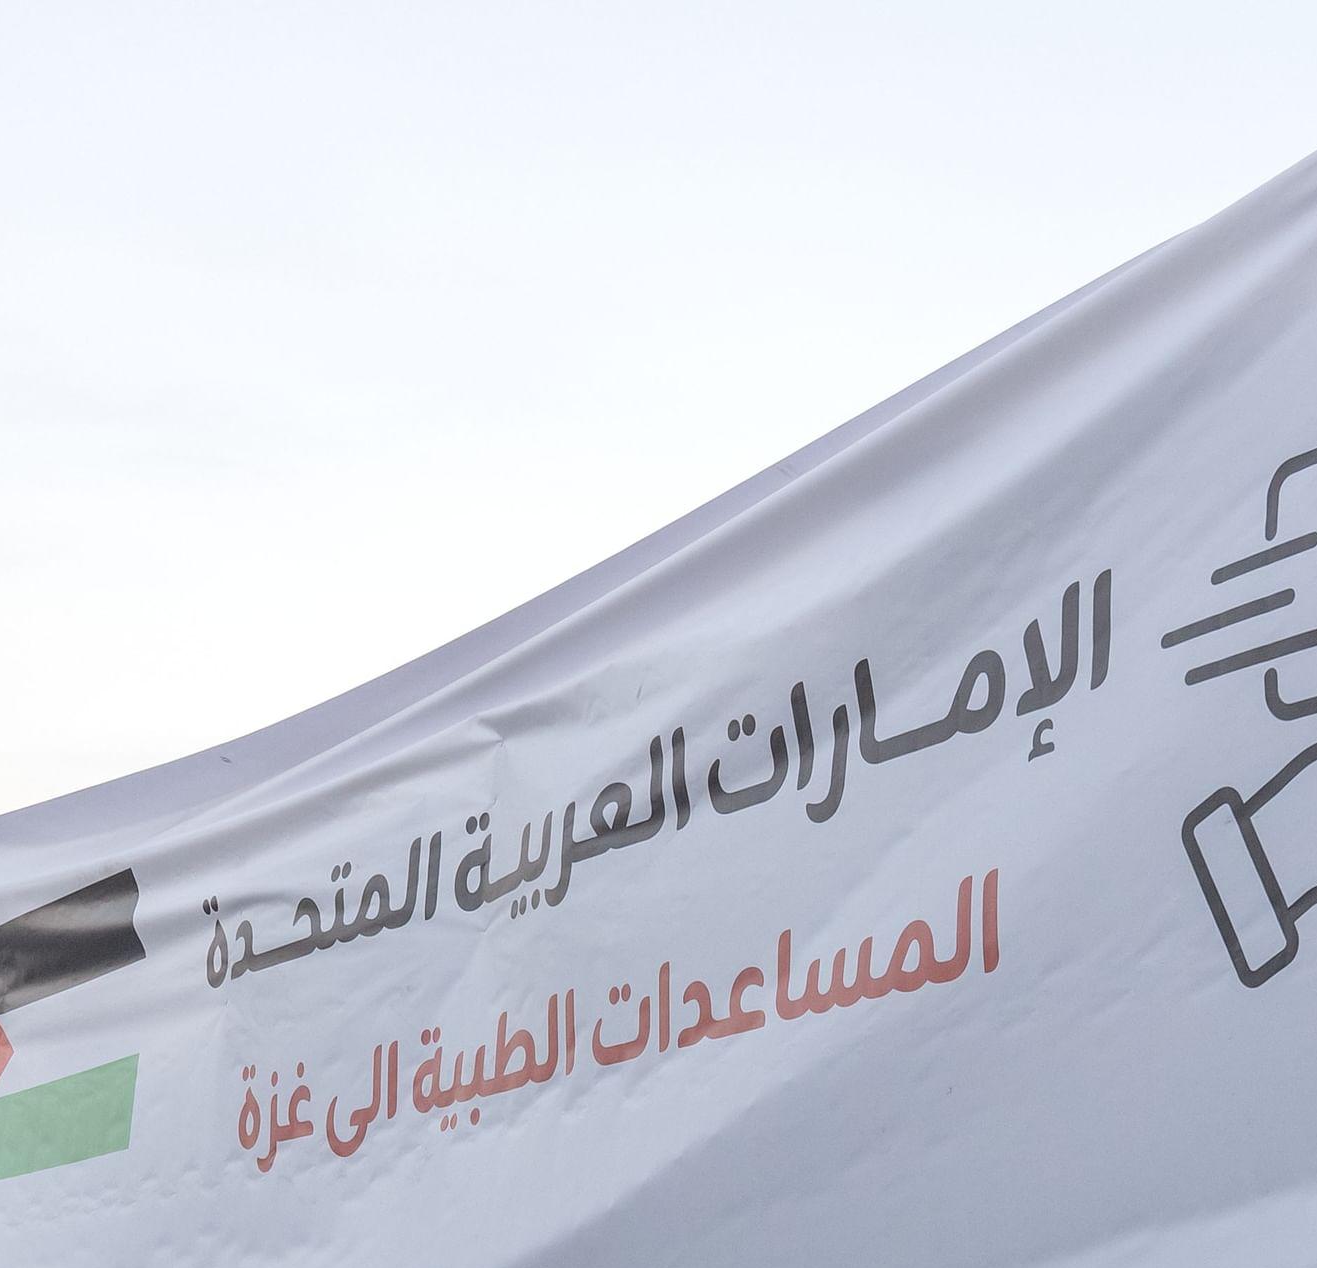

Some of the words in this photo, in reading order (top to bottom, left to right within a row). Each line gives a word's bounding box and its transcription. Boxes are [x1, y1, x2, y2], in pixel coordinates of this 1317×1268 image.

[707, 568, 1113, 824] الإمارات
[454, 726, 690, 922] العربية
[205, 829, 442, 990] المتحدة
[592, 869, 999, 1067] المساعدات
[238, 1062, 313, 1173] غزة
[326, 1040, 398, 1158] الى
[414, 989, 576, 1133] الطبية
